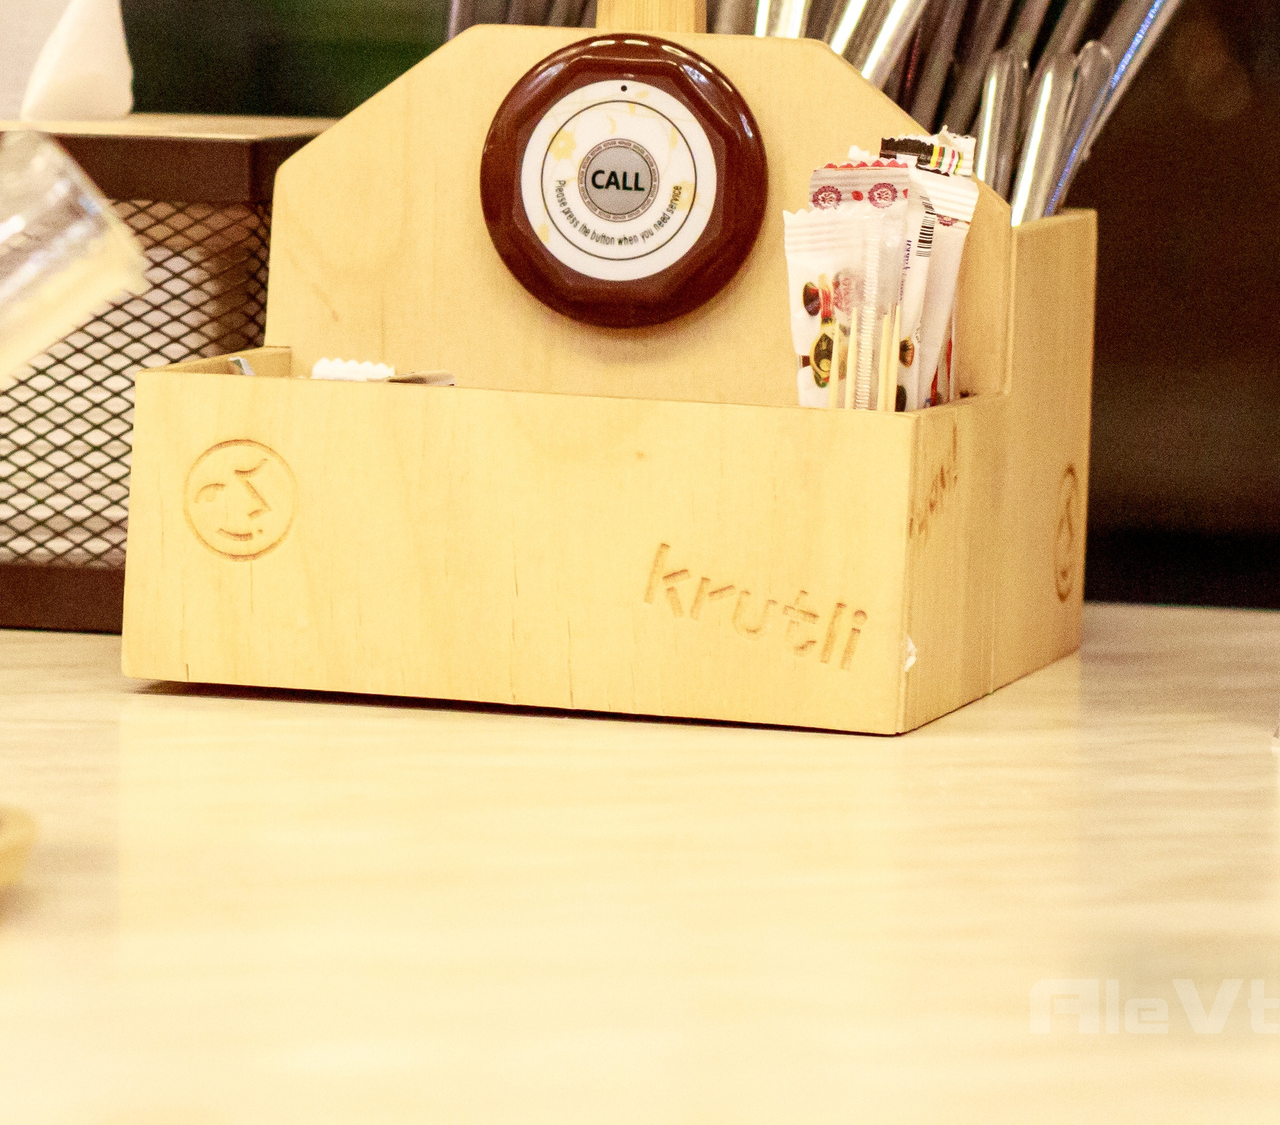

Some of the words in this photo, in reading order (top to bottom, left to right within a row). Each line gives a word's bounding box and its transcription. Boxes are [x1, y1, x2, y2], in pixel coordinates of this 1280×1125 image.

[591, 169, 645, 192] CALL
[555, 179, 568, 207] Please
[666, 185, 683, 215] service
[560, 206, 580, 228] press
[653, 211, 671, 232] need
[578, 223, 591, 237] the
[590, 229, 615, 246] button
[617, 234, 639, 246] when
[640, 228, 655, 244] you
[643, 542, 868, 672] krutli
